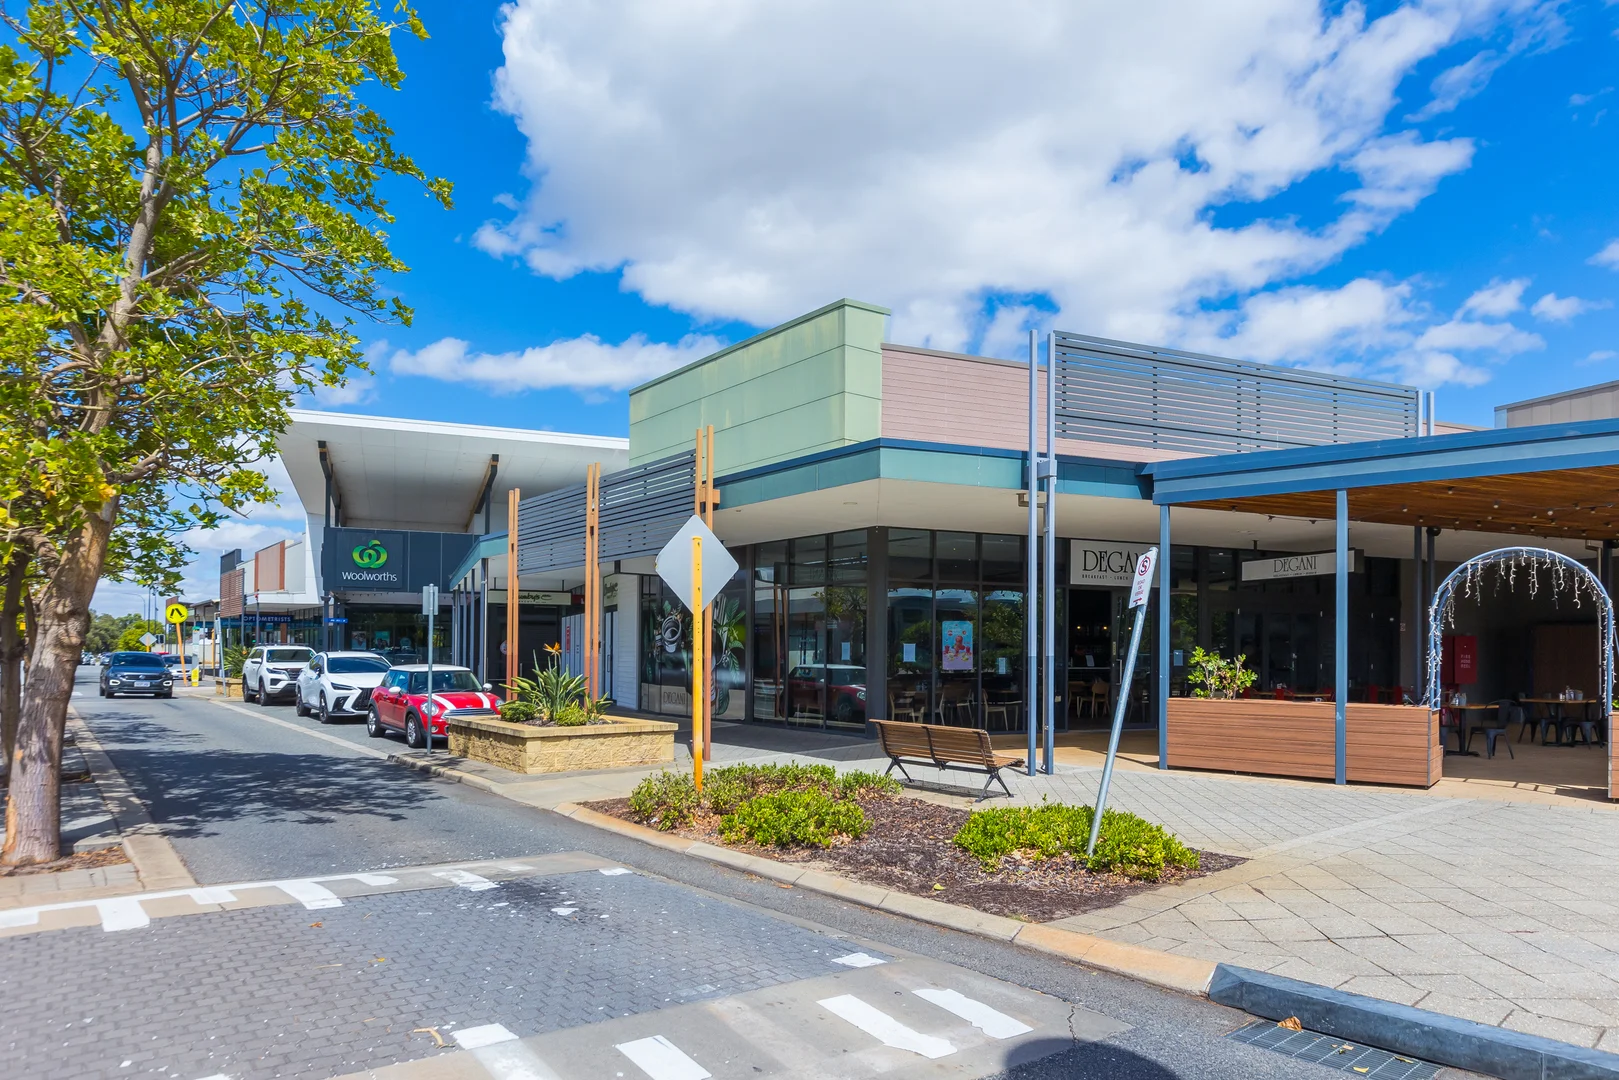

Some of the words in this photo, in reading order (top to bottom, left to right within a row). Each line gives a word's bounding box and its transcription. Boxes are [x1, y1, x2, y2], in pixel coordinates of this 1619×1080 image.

[1082, 549, 1144, 574] DEGA
[1273, 555, 1318, 573] DEGANI
[341, 571, 398, 582] Woolworths
